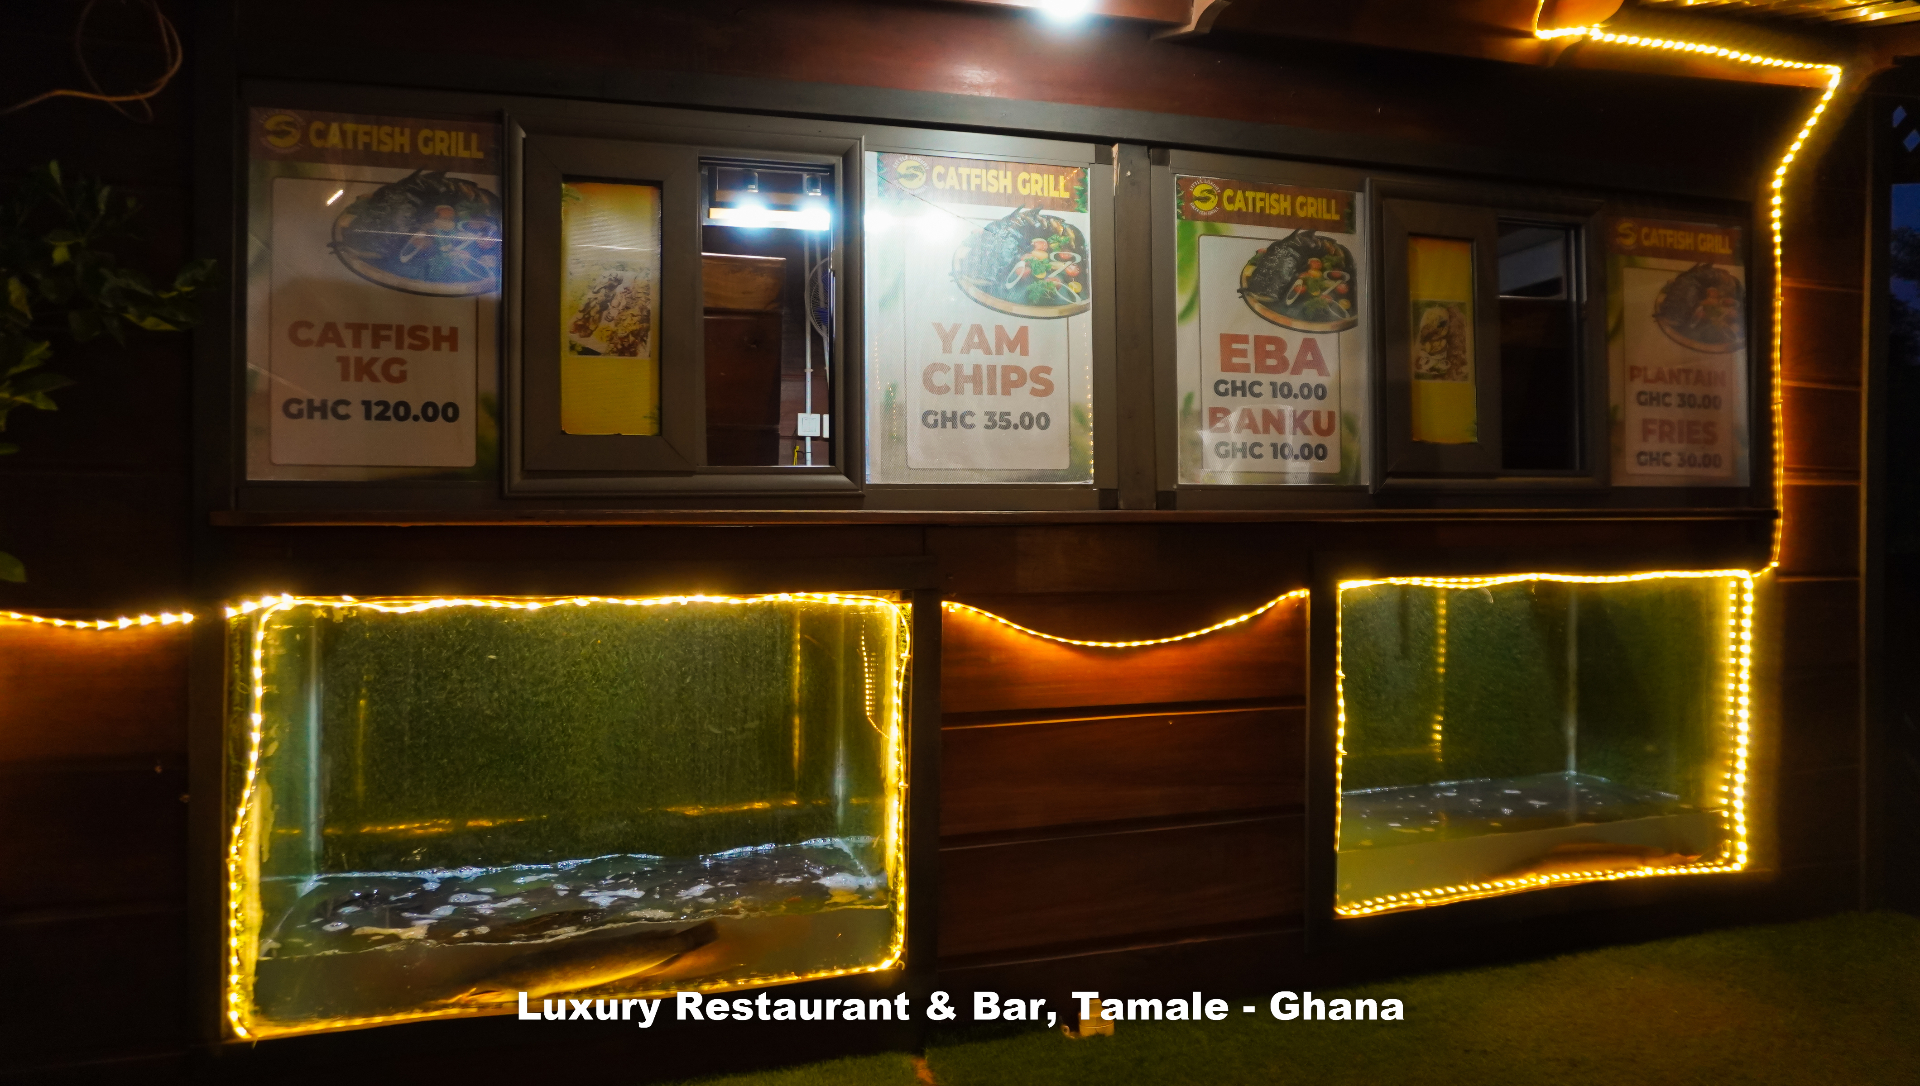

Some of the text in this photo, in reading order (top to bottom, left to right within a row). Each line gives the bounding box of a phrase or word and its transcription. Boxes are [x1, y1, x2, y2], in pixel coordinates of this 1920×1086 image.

[308, 121, 410, 155] CATFISH
[417, 128, 484, 159] GRILL
[932, 165, 1012, 194] CATFISH
[1017, 171, 1070, 199] GRILL
[1222, 188, 1340, 220] CATFISH GRILL
[1641, 227, 1694, 250] CATFISH
[1697, 232, 1732, 254] GRILL
[288, 320, 459, 353] CATFISH
[931, 322, 1030, 356] YAM
[1219, 333, 1331, 377] EBA
[336, 356, 408, 384] 1KG
[922, 362, 1055, 398] CHIPS
[1629, 366, 1727, 388] PLANTAIN
[1213, 379, 1328, 401] GHC 10.00
[1637, 391, 1722, 410] GHC 30.00
[281, 397, 460, 423] GHC 120.00
[921, 409, 1051, 431] GHC 35.00
[1208, 406, 1336, 437] BANKU
[1642, 418, 1718, 446] FRIES
[1214, 441, 1328, 461] GHC 10.00
[1636, 451, 1722, 469] GHC 30.00
